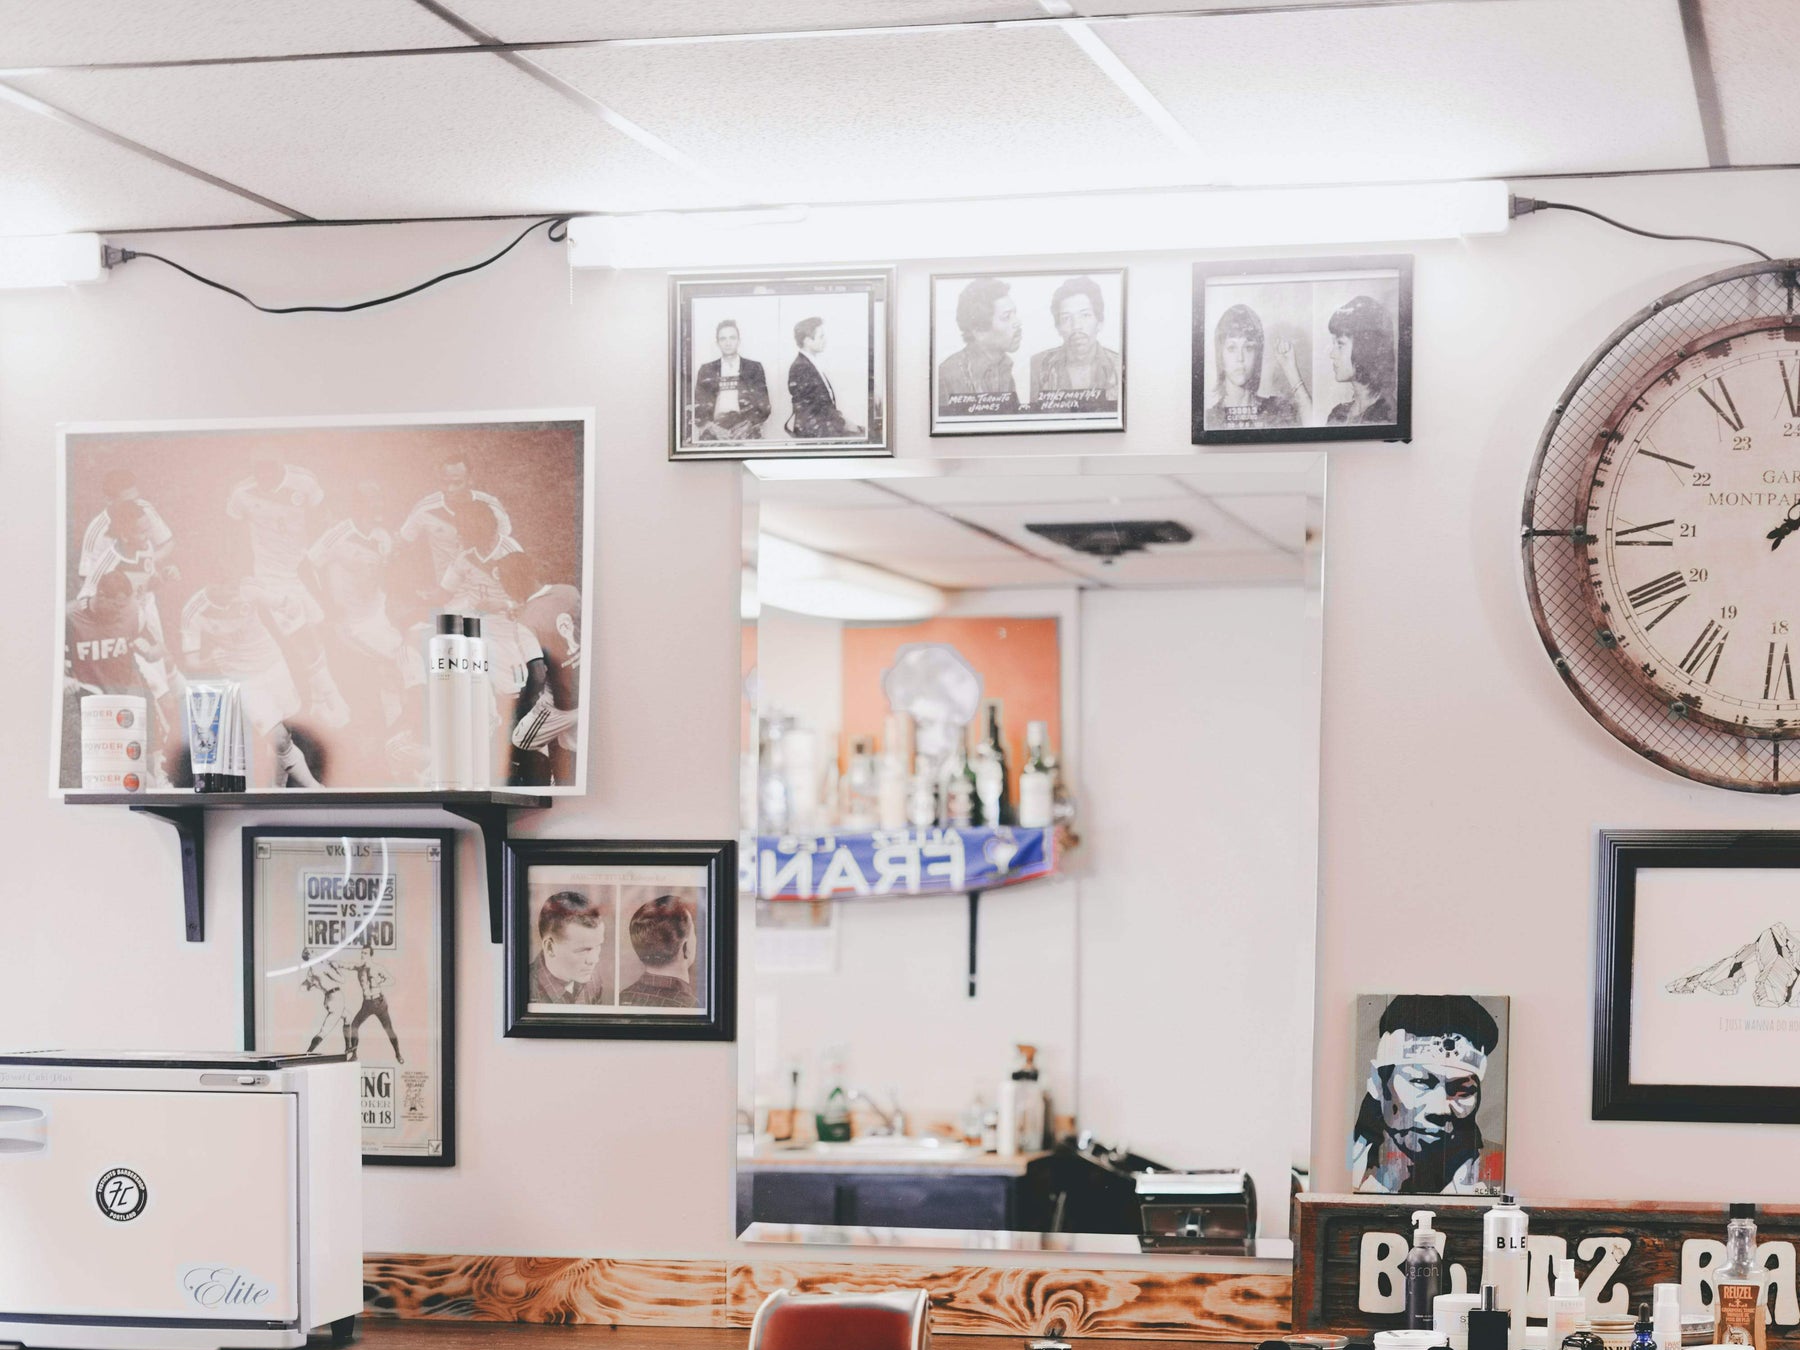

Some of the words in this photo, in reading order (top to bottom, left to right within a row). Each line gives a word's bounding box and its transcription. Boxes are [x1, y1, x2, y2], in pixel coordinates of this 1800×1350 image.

[967, 403, 1000, 413] JAMES
[1040, 400, 1079, 411] HENDRIX
[1732, 436, 1752, 451] 23
[1692, 472, 1711, 487] 22
[1680, 523, 1698, 538] 21
[1689, 568, 1708, 583] 20
[1720, 605, 1738, 620] 19
[1771, 621, 1789, 635] 18
[76, 637, 128, 661] FIFA
[431, 658, 468, 670] END
[307, 876, 379, 901] OREGON
[341, 904, 361, 917] VS.
[308, 920, 394, 947] IRELAND
[379, 1110, 392, 1125] 18
[109, 1211, 137, 1221] PORTLAND
[1496, 1236, 1526, 1249] BLE
[183, 1267, 270, 1309] Elite
[1358, 1231, 1632, 1330] BTZ
[1723, 1286, 1753, 1300] REUZEL
